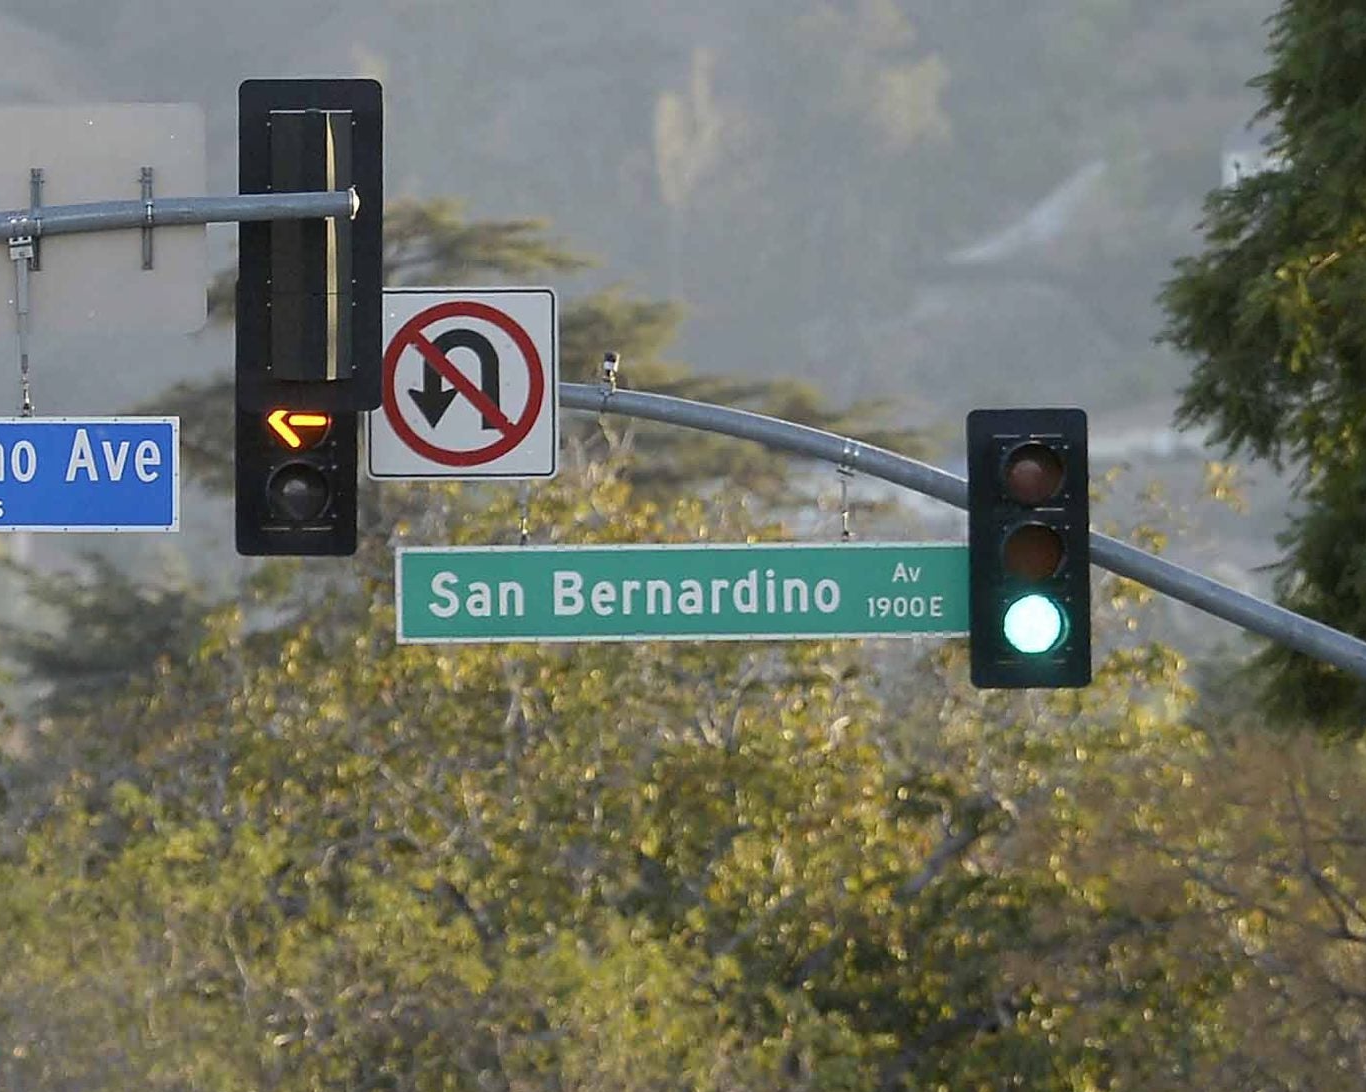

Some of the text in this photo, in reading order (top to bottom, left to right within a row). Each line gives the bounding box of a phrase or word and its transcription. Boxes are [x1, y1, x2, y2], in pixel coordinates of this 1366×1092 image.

[66, 429, 161, 484] Ave
[429, 568, 840, 618] San Bernardino
[892, 561, 922, 584] Av
